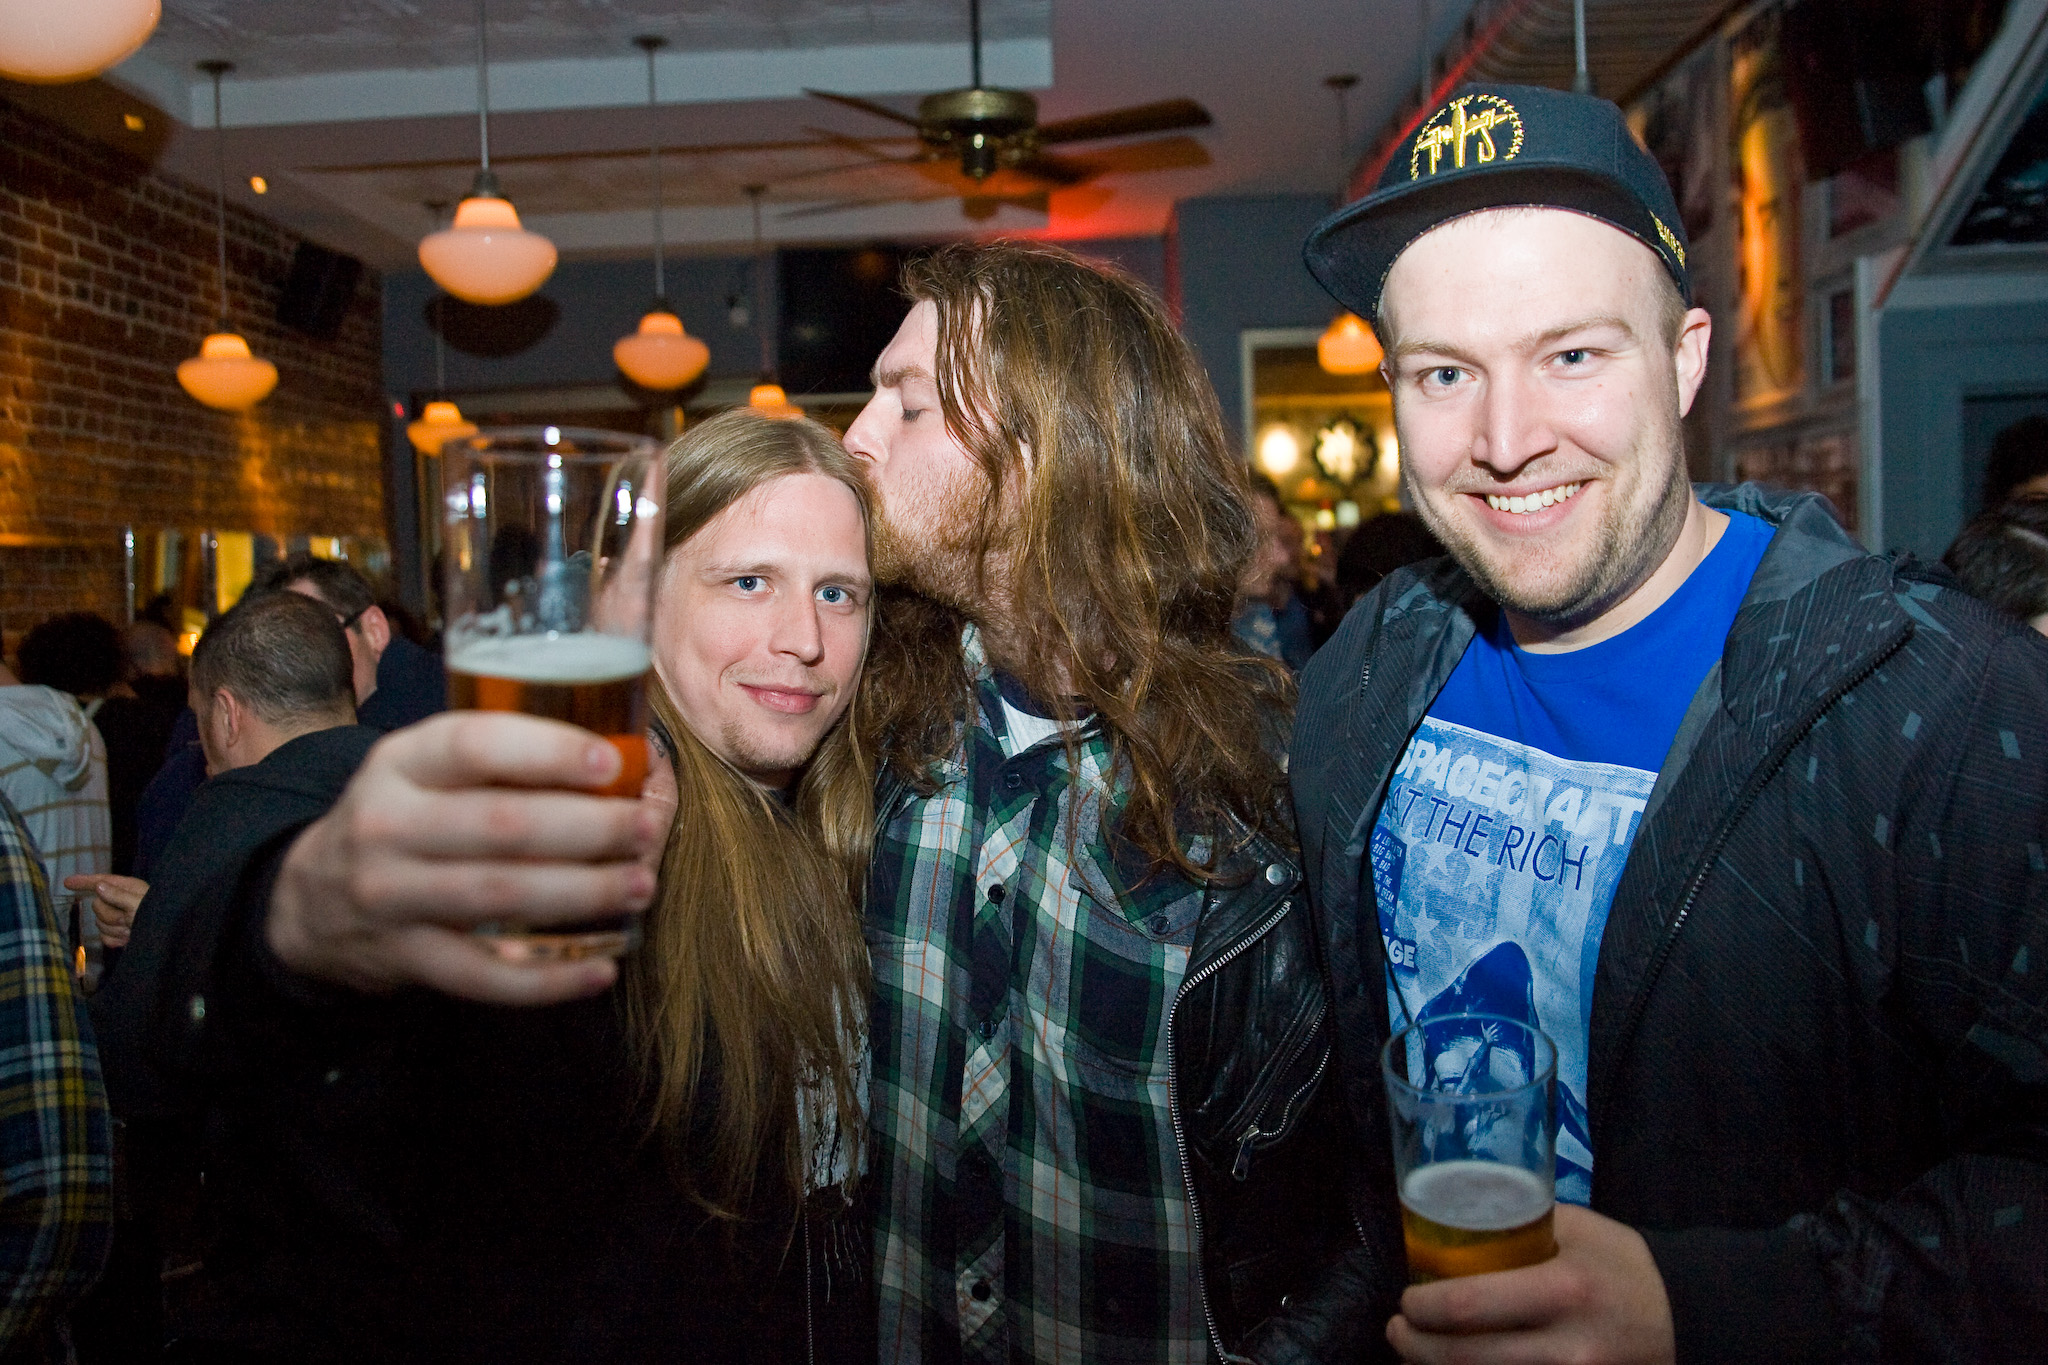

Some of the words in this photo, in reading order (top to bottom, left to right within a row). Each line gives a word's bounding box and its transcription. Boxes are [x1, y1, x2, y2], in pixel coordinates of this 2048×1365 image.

[1385, 785, 1423, 828] AT
[1424, 797, 1494, 858] THE
[1496, 824, 1589, 891] RICH
